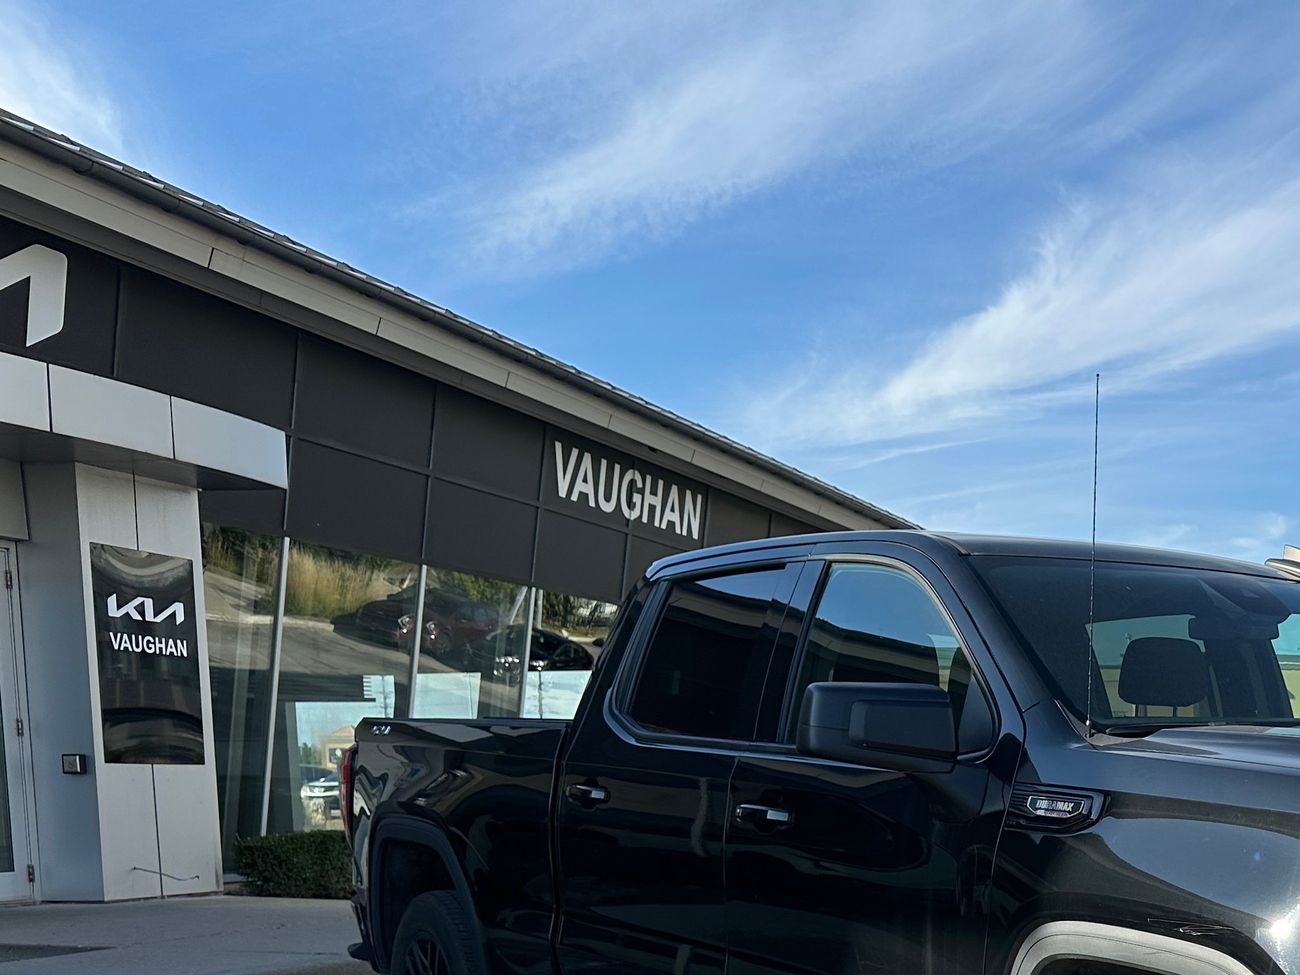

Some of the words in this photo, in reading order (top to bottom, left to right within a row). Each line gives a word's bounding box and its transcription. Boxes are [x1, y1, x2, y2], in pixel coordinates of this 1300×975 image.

[555, 441, 702, 540] VAUGHAN
[107, 593, 184, 625] KIA
[110, 632, 187, 657] VAUGHAN
